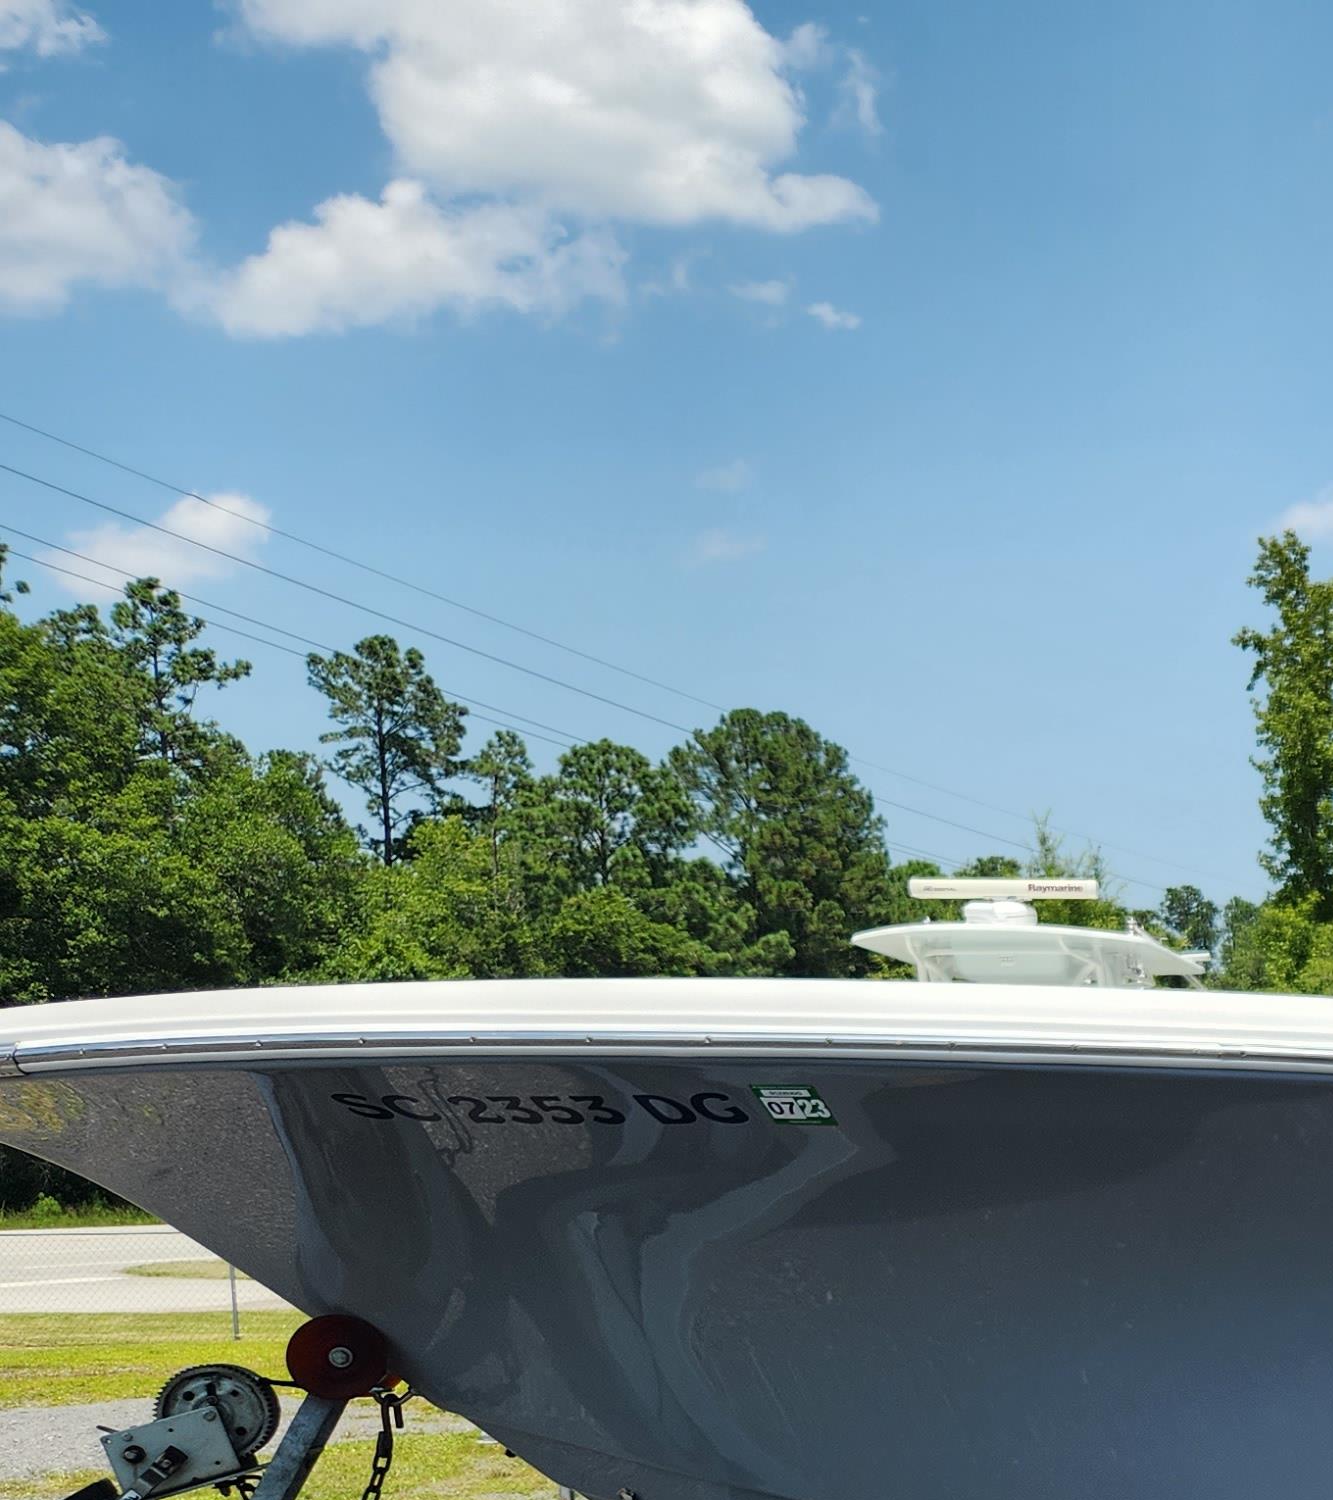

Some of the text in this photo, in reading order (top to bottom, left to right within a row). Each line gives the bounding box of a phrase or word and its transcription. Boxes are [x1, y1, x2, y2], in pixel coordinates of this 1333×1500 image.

[330, 1092, 749, 1125] SC 2353 DG
[767, 1099, 832, 1118] 07 23
